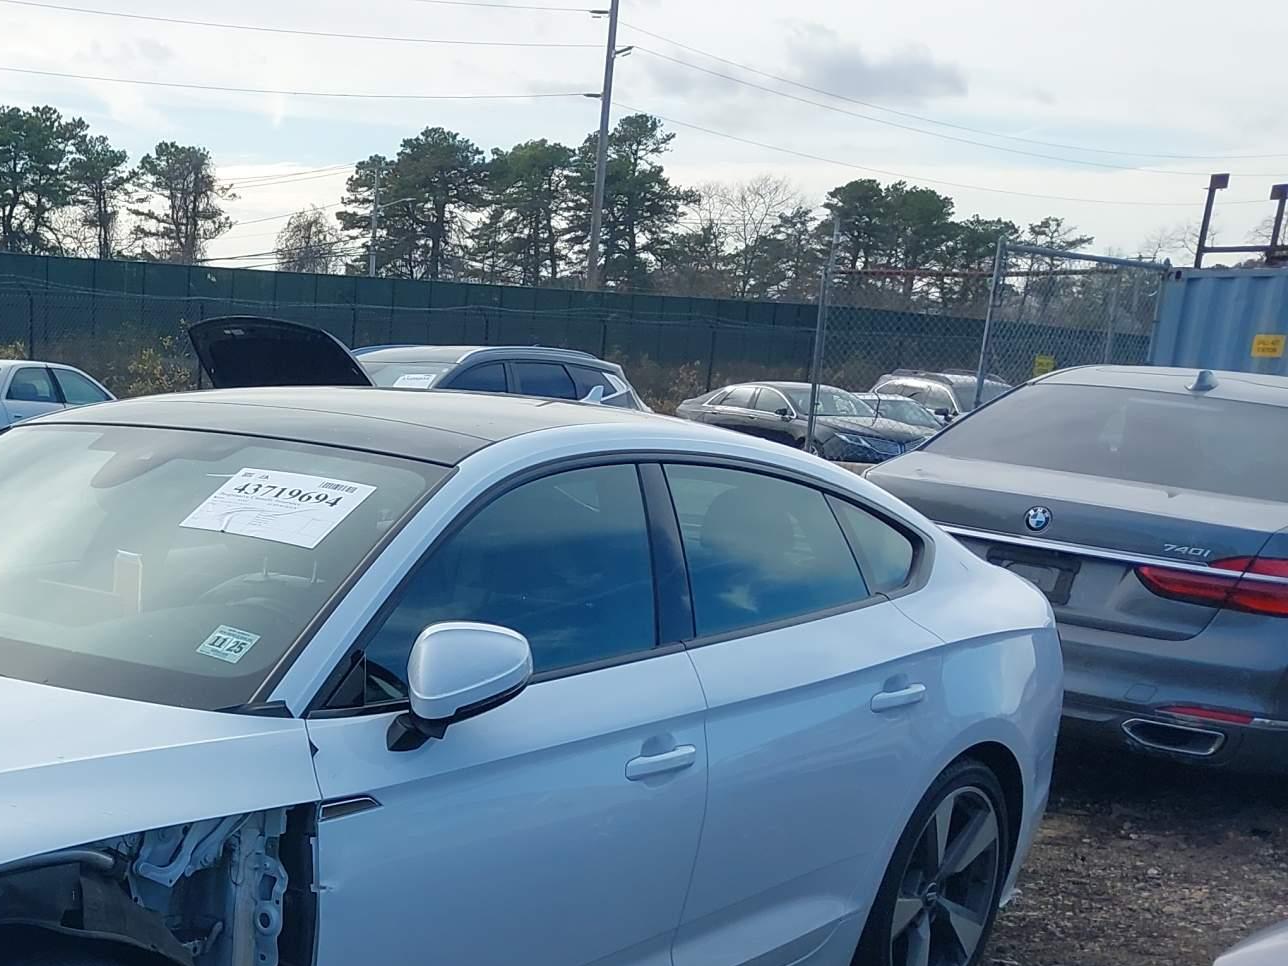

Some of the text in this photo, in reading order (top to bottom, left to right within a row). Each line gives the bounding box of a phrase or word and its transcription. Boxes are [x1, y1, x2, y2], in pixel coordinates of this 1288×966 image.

[233, 482, 343, 508] 43719694
[208, 635, 228, 649] 11
[225, 640, 248, 654] 25
